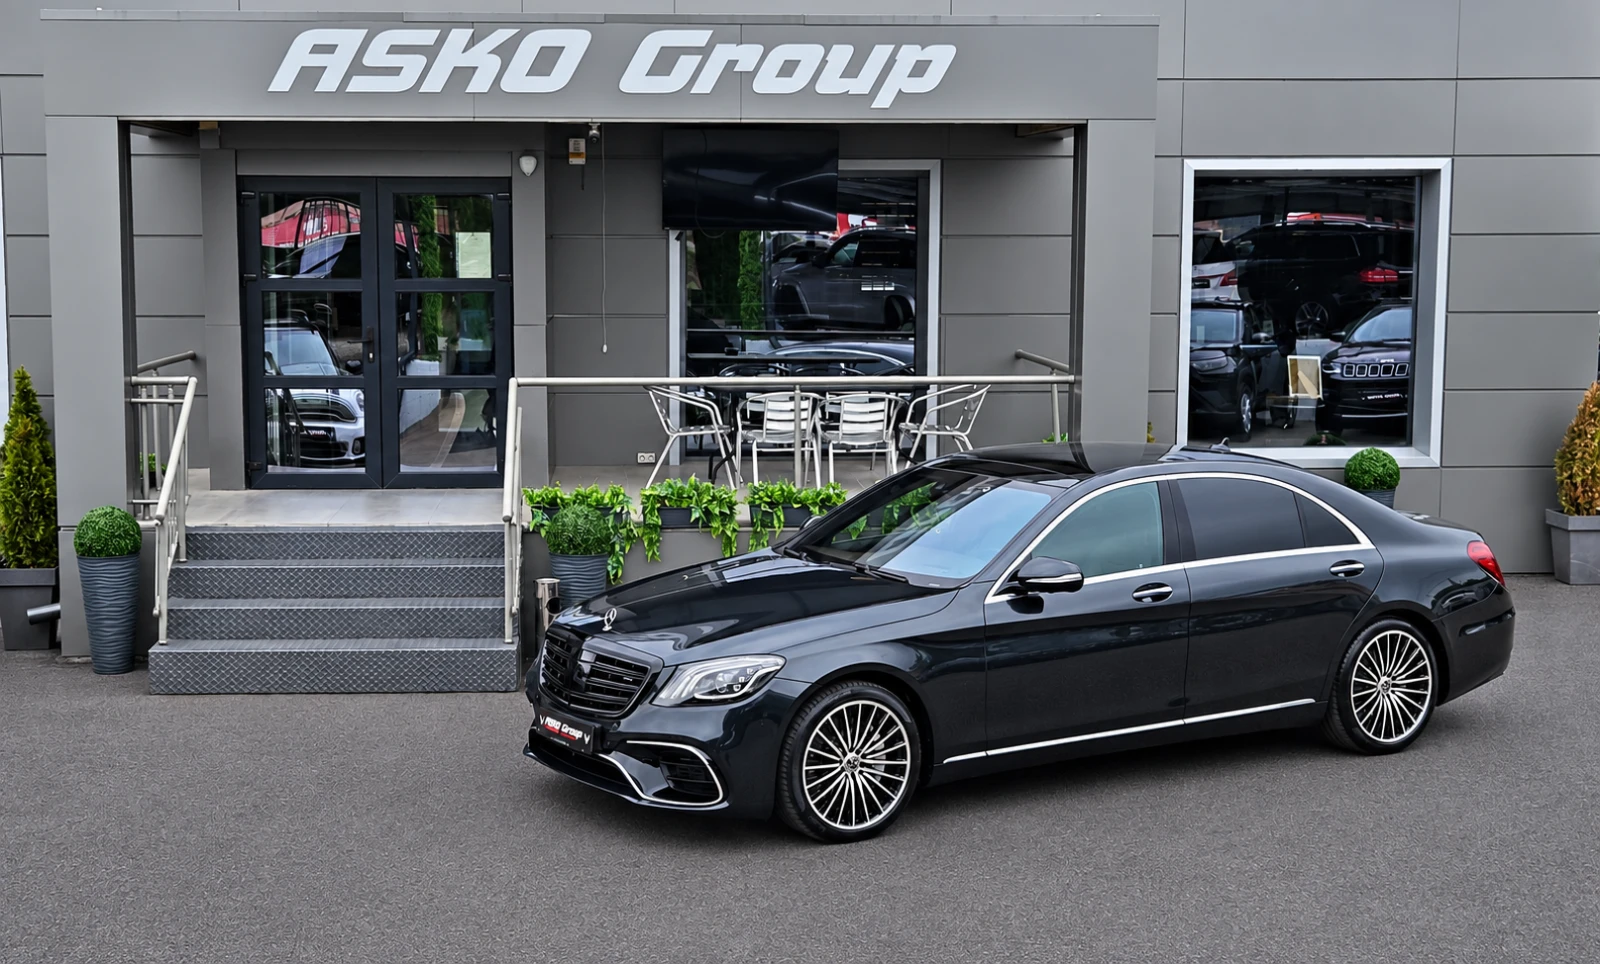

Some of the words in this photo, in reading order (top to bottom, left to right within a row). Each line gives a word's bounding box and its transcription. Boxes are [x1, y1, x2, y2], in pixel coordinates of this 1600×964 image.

[268, 29, 592, 93] ASKO
[620, 30, 957, 109] Group
[561, 723, 584, 740] Group
